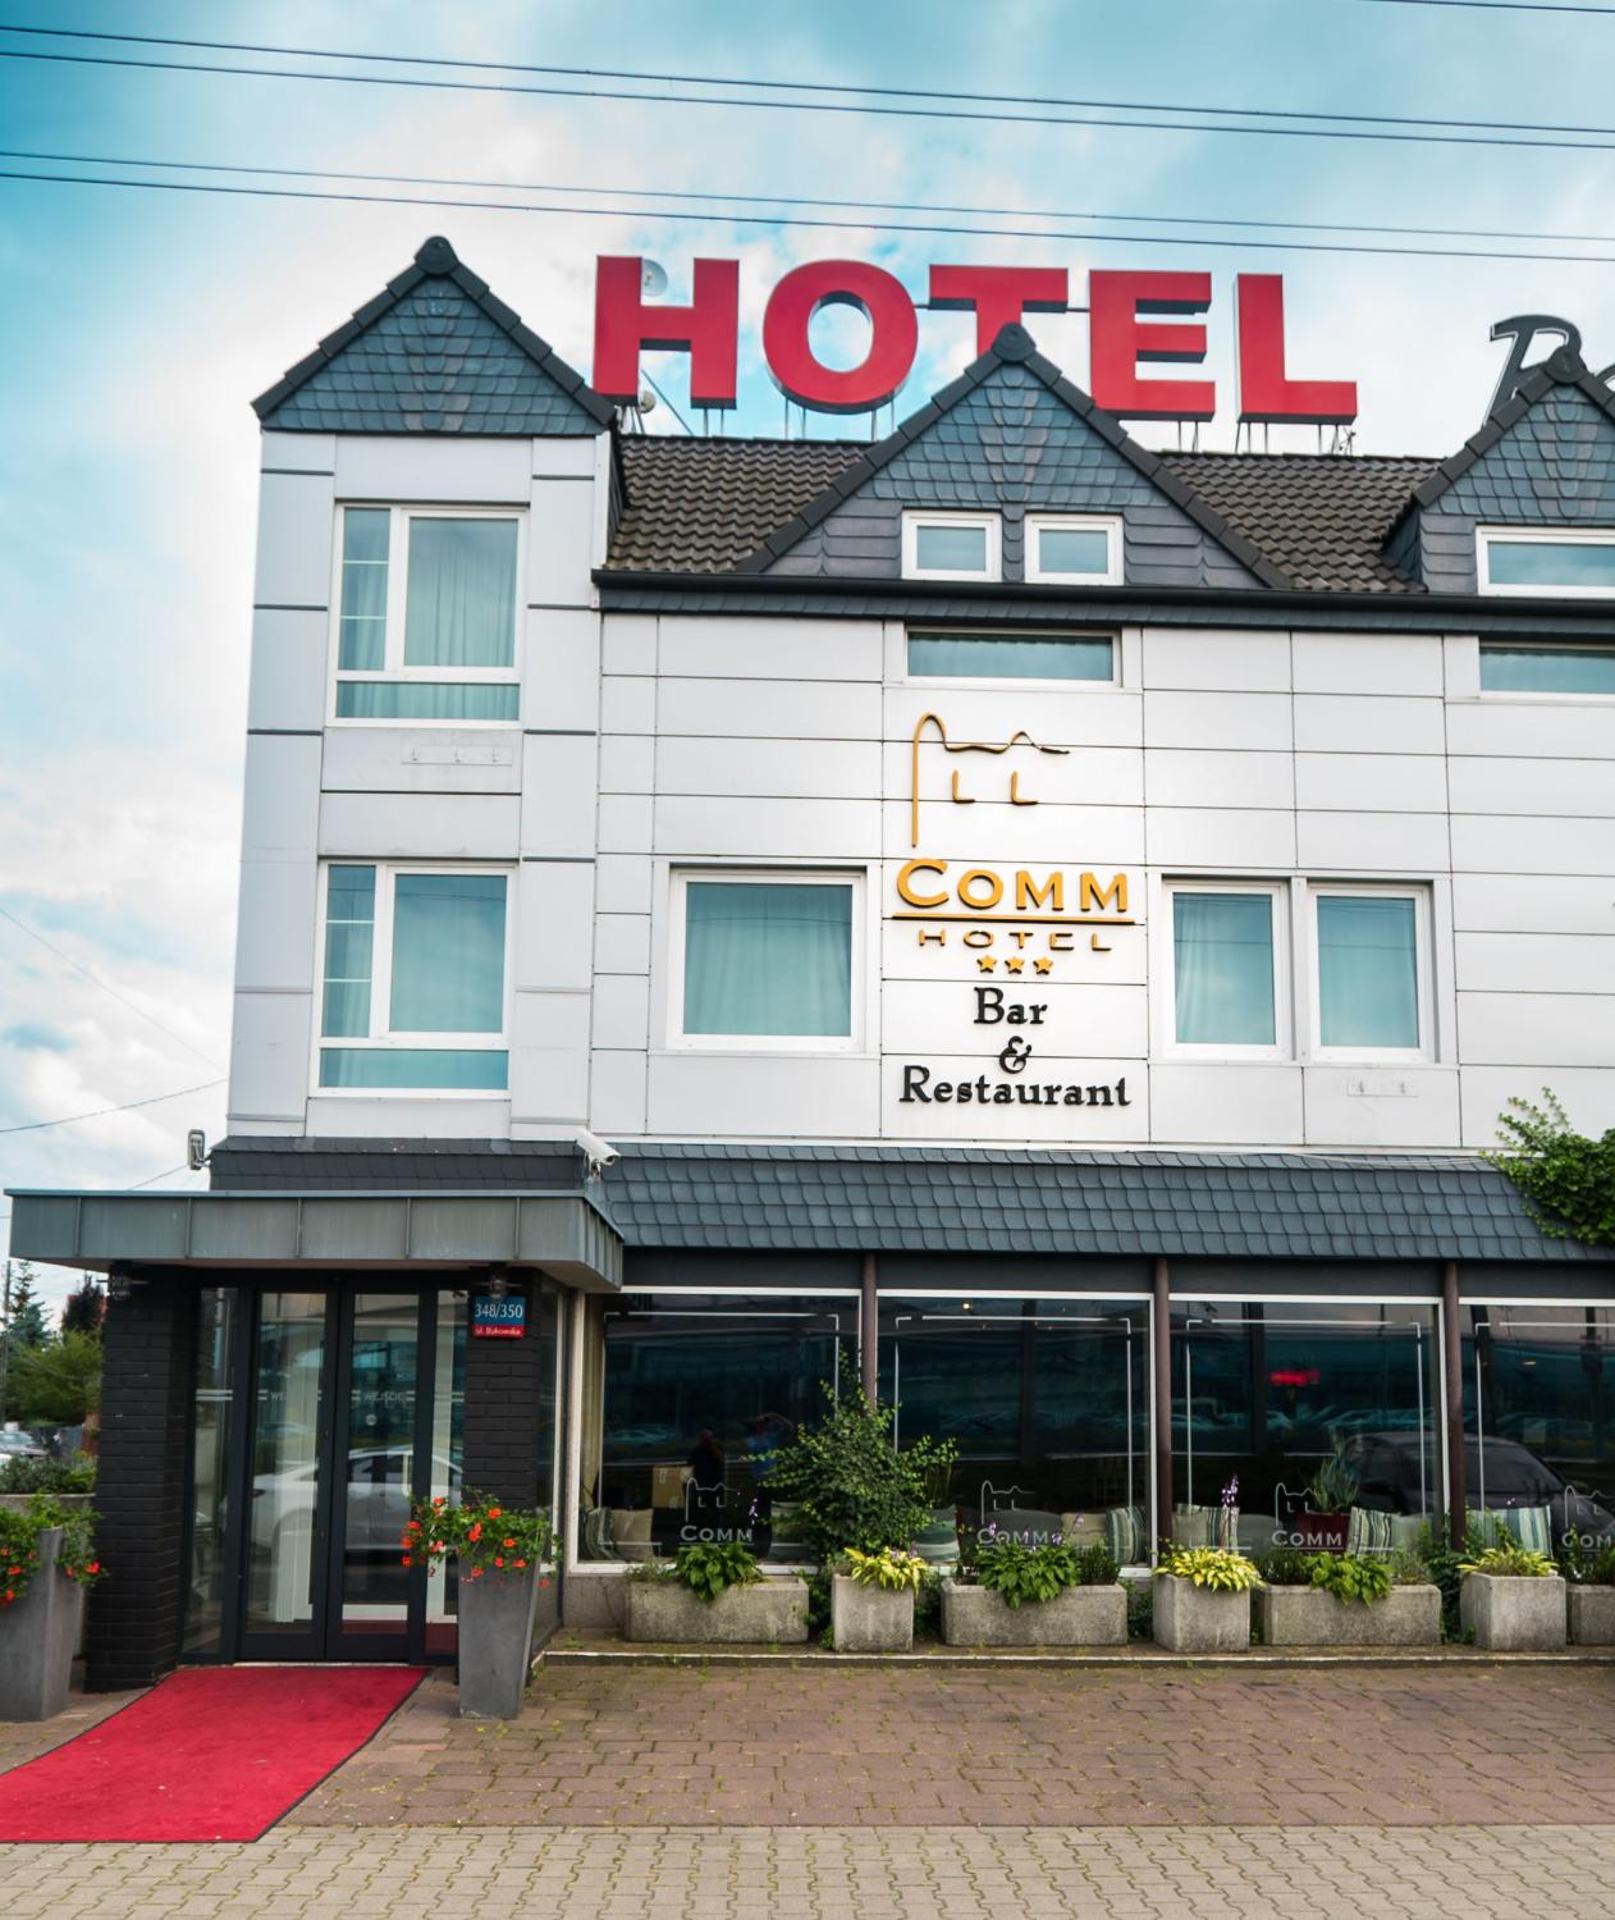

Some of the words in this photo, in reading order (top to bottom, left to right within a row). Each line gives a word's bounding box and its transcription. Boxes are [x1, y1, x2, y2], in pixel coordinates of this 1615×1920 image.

[594, 255, 1357, 425] HOTEL
[897, 858, 1128, 912] COMM
[918, 928, 1112, 951] HOTEL
[973, 986, 1048, 1025] Bar
[999, 1035, 1032, 1074] &
[899, 1065, 1132, 1106] Restaurant
[474, 1303, 523, 1319] 348/350
[680, 1525, 753, 1542] COMM
[1271, 1529, 1343, 1547] COMM
